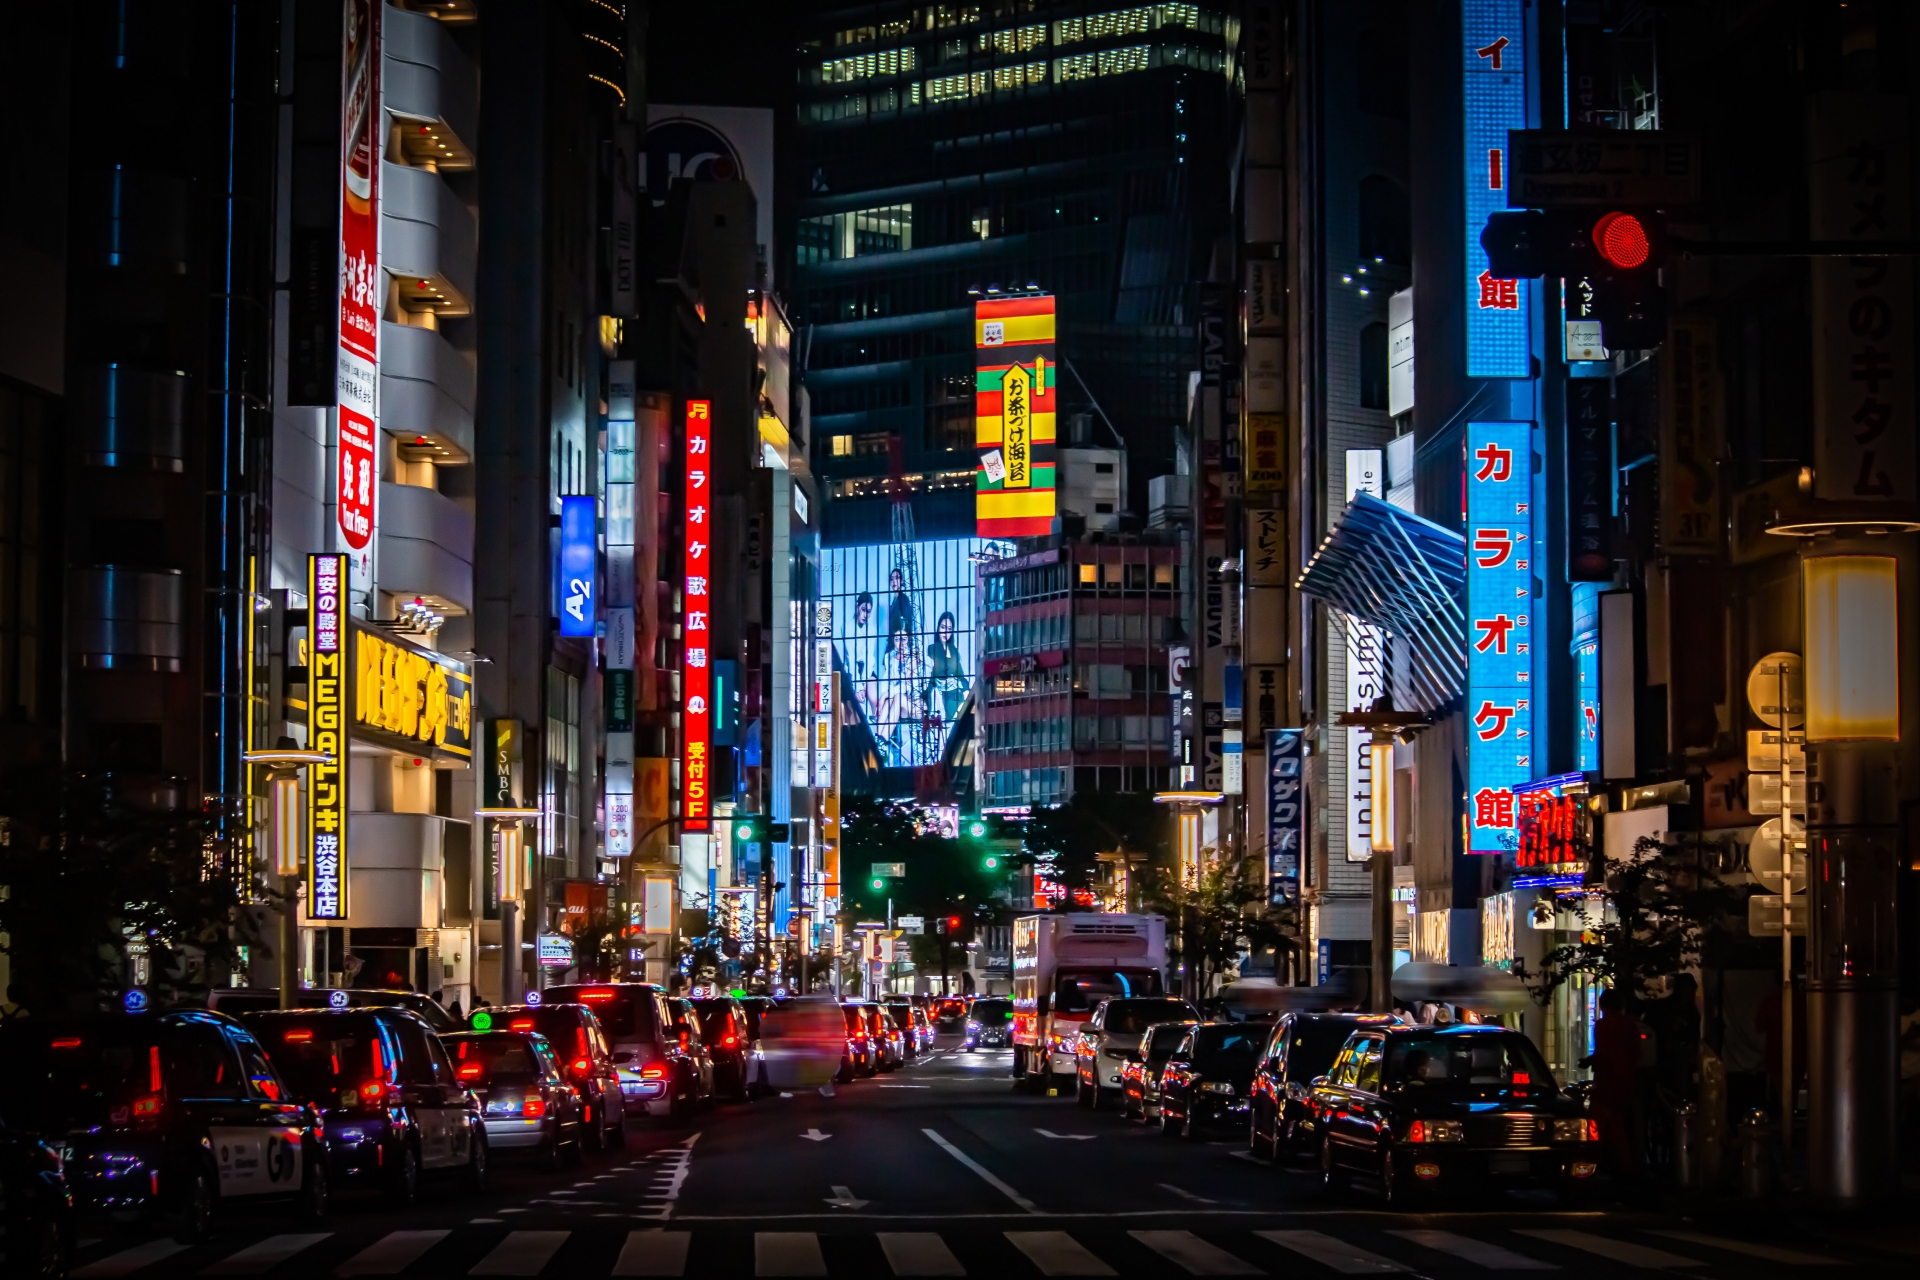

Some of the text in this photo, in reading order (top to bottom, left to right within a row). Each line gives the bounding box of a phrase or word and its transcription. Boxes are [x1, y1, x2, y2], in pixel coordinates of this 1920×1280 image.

[1518, 143, 1689, 177] 道玄坂二丁目
[1578, 276, 1593, 317] ヘッド
[1008, 377, 1026, 482] お茶づけ海苔
[343, 450, 370, 506] 免税
[342, 503, 369, 537] Tax Free
[1256, 511, 1278, 571] ストレッチ
[1680, 513, 1711, 537] 3F
[687, 436, 707, 667] カラオケ歌広場
[317, 557, 337, 650] 驚安の殿堂
[566, 578, 590, 622] A2
[1207, 556, 1222, 649] SHIBUYA
[1473, 443, 1514, 829] カラオケ館
[498, 751, 510, 801] SMBC
[687, 741, 706, 817] 受付5F
[612, 814, 627, 823] BAR
[1272, 733, 1299, 903] クロサワ楽器店
[315, 834, 337, 917] 渋谷本店
[568, 905, 585, 914] au
